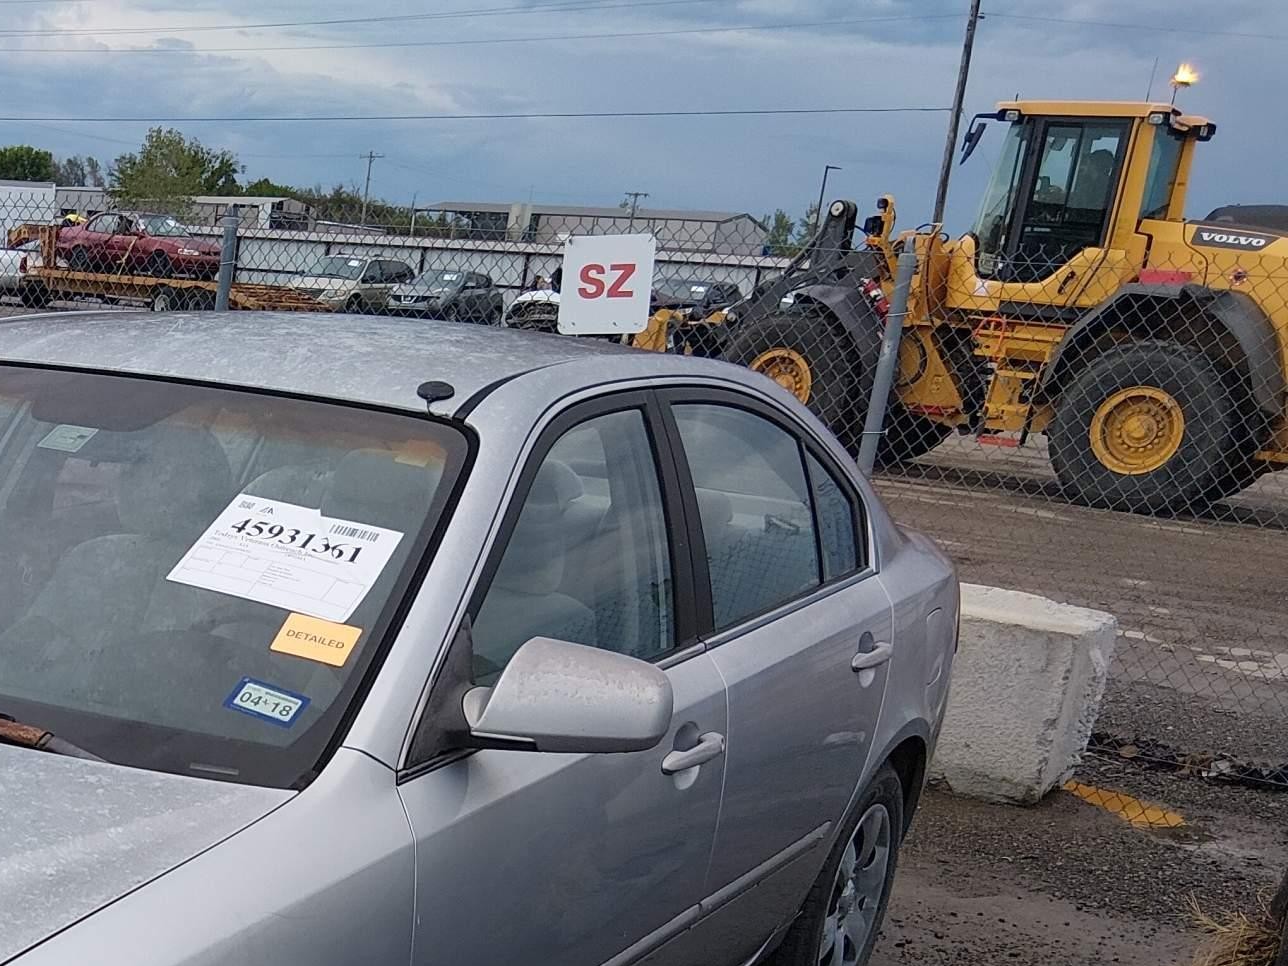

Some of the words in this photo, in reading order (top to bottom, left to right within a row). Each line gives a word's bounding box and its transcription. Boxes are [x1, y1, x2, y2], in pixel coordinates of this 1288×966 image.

[1200, 232, 1266, 247] VOLVO
[577, 263, 636, 299] SZ
[231, 518, 363, 563] 45931361
[286, 629, 345, 649] DETAILED
[239, 691, 263, 706] 04
[271, 702, 293, 717] 18
